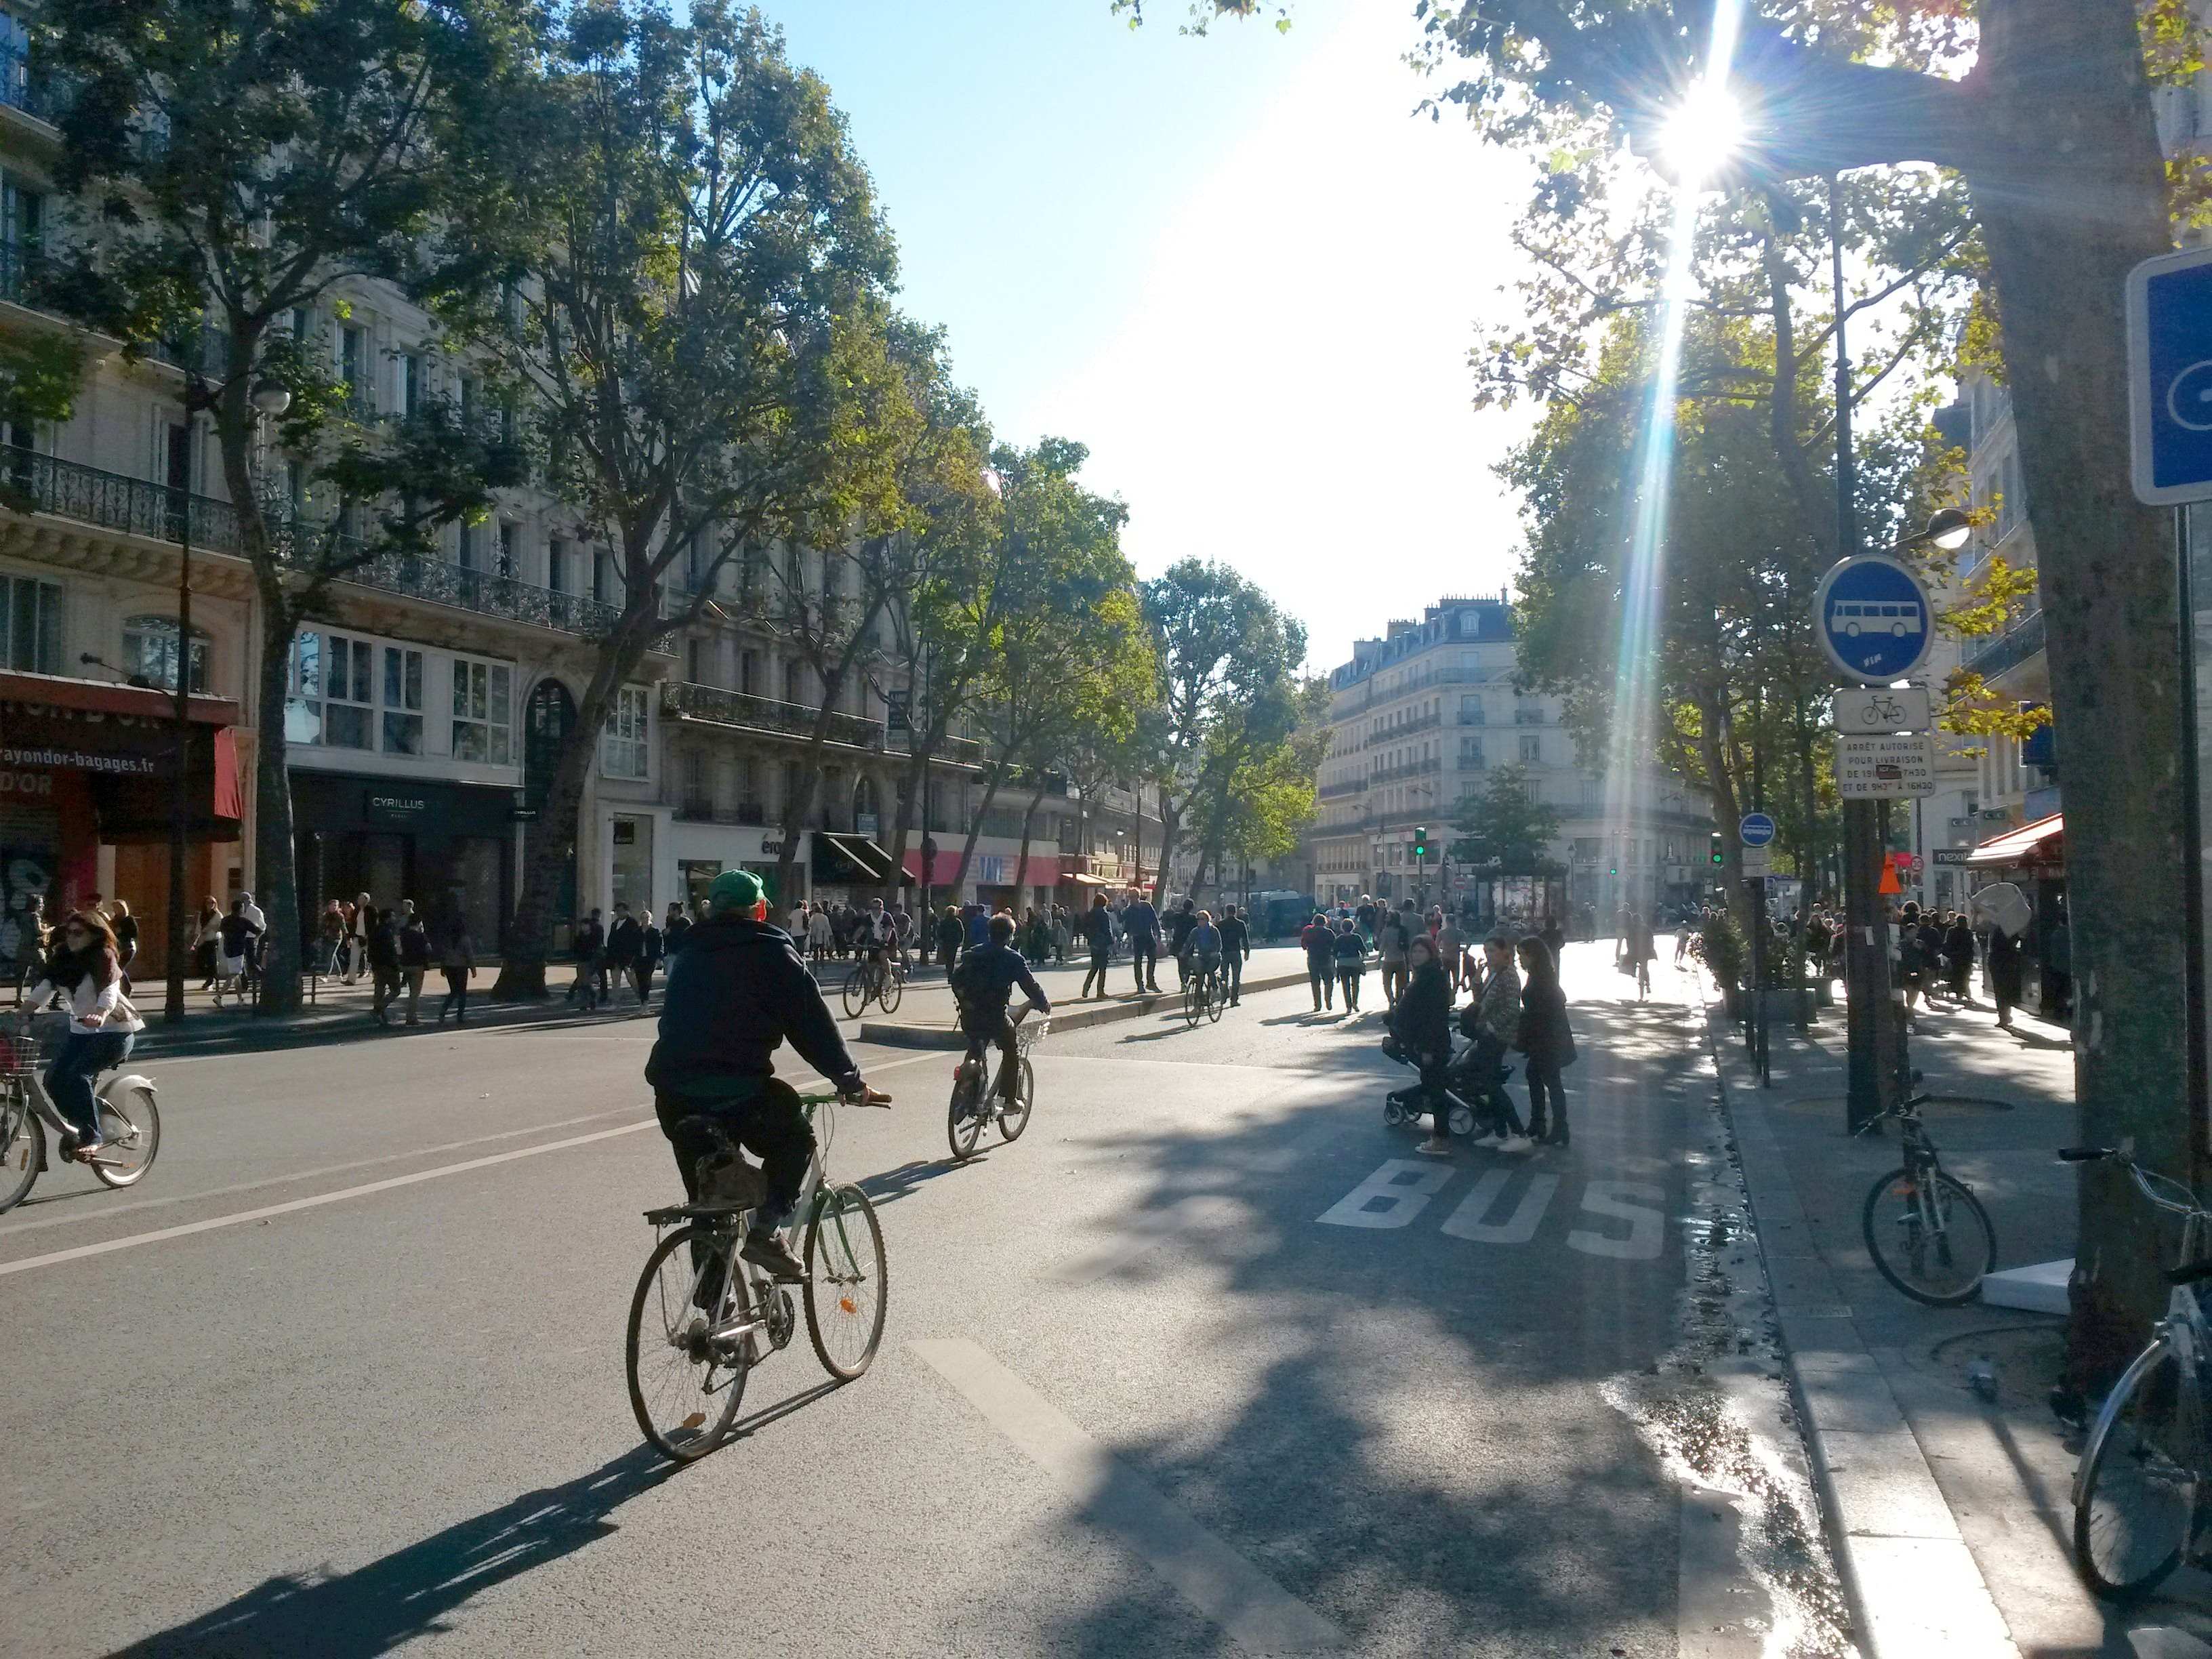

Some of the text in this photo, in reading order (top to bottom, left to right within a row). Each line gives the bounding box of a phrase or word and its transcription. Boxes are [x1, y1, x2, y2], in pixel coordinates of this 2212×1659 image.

[1847, 741, 1875, 751] ARRÊT
[1849, 756, 1923, 764] POUR LIVRAISON
[1847, 770, 1858, 778] DE
[1843, 783, 1852, 792] ET
[1908, 781, 1932, 790] 16H30
[373, 797, 424, 809] CYRILLUS
[1314, 1158, 1666, 1261] BUS
